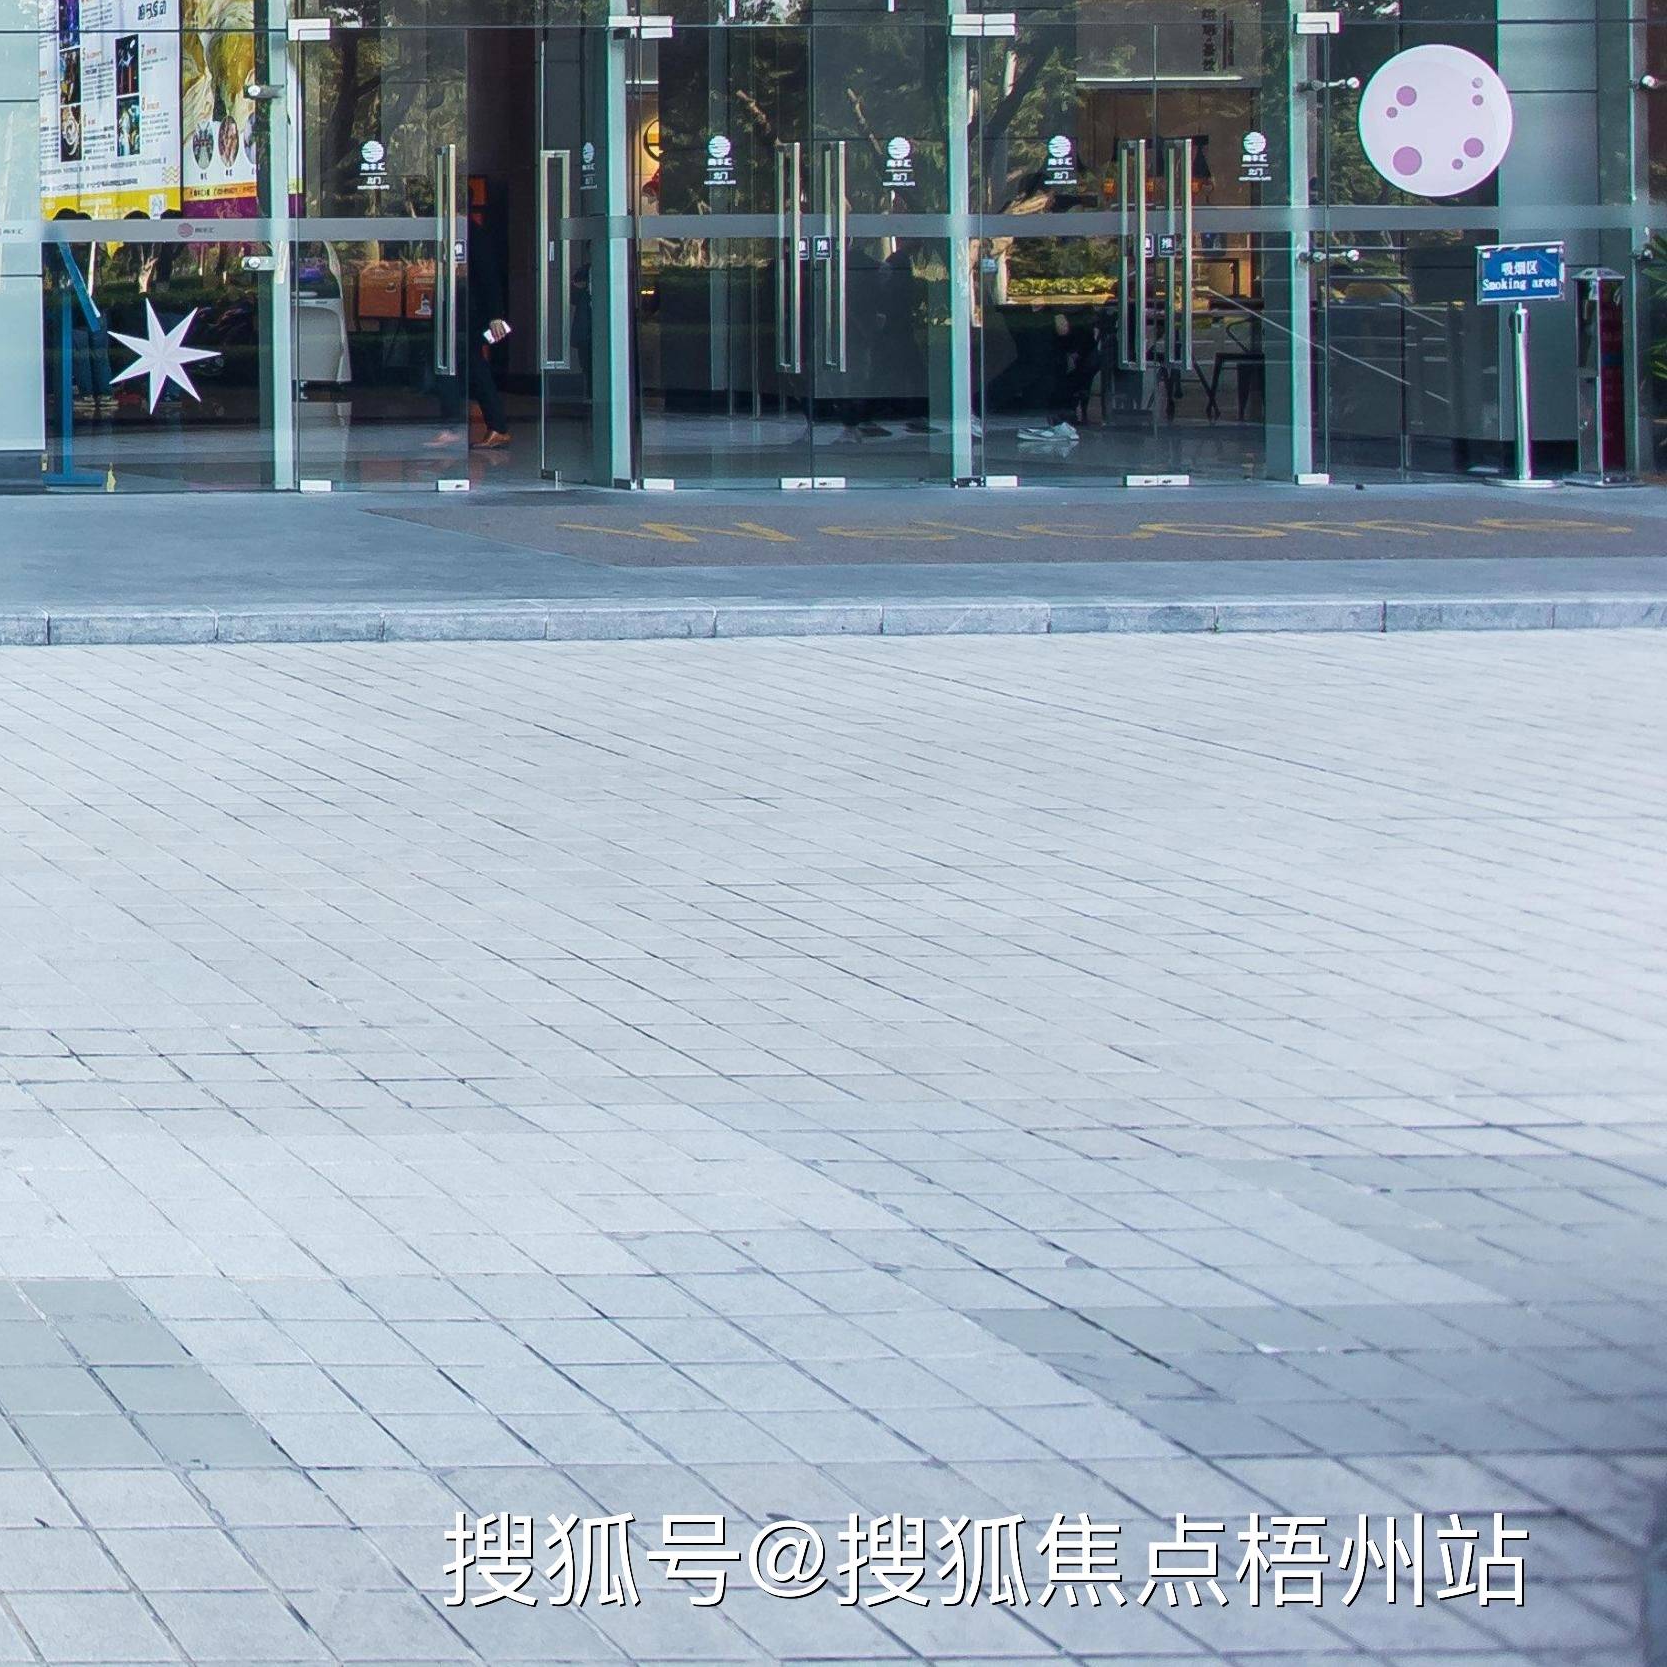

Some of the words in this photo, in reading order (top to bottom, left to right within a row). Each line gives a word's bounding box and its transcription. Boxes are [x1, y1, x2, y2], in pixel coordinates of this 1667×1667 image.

[1501, 260, 1538, 276] 吸烟区
[1482, 279, 1527, 291] Smoking
[1532, 278, 1557, 288] area
